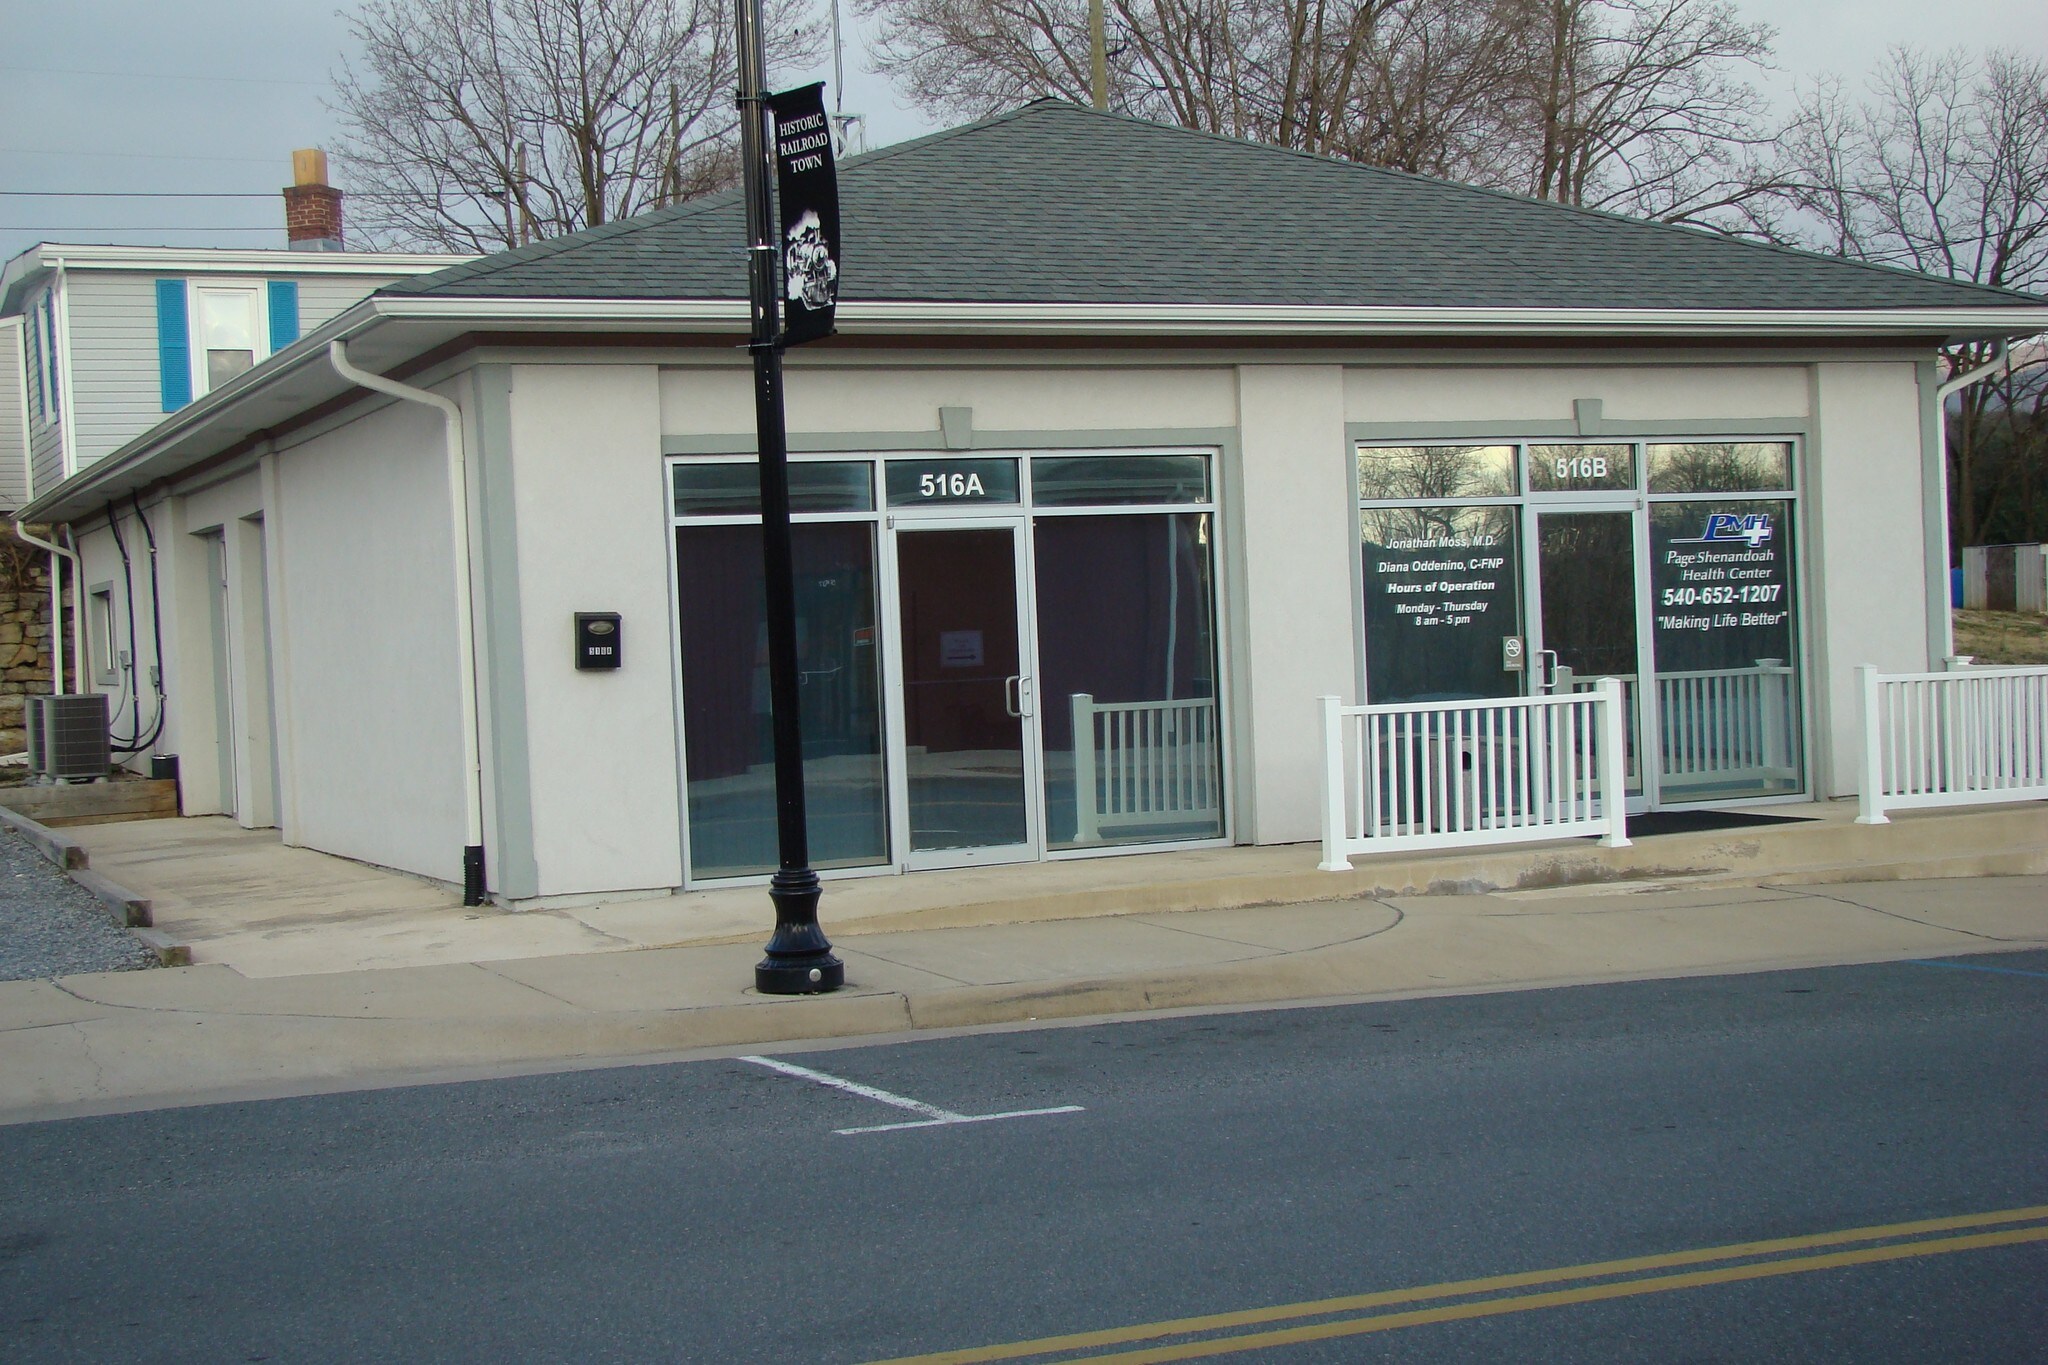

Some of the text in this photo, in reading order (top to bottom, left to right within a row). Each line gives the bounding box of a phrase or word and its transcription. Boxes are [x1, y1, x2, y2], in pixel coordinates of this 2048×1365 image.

[780, 113, 823, 136] HISTORIC
[781, 132, 828, 156] RAILROAD
[791, 154, 823, 173] TOWN
[1556, 457, 1607, 478] 516B
[920, 473, 985, 497] 516A
[1702, 514, 1769, 541] PMH
[1386, 535, 1496, 549] Jonathan Moss, M.D.
[1378, 558, 1504, 573] Diana Oddenino, C-FNP
[1666, 549, 1774, 567] Page Shenandoah
[1682, 567, 1772, 581] Health Center
[1387, 580, 1495, 594] Hours of Operation
[1662, 584, 1781, 606] 540-652-1207
[1396, 604, 1435, 614] Monday
[1443, 601, 1488, 612] Thursday
[1415, 616, 1421, 625] 8
[1423, 616, 1438, 625] am
[1446, 615, 1453, 625] 5
[1454, 615, 1470, 627] pm
[1658, 611, 1787, 631] "Making Life Better"
